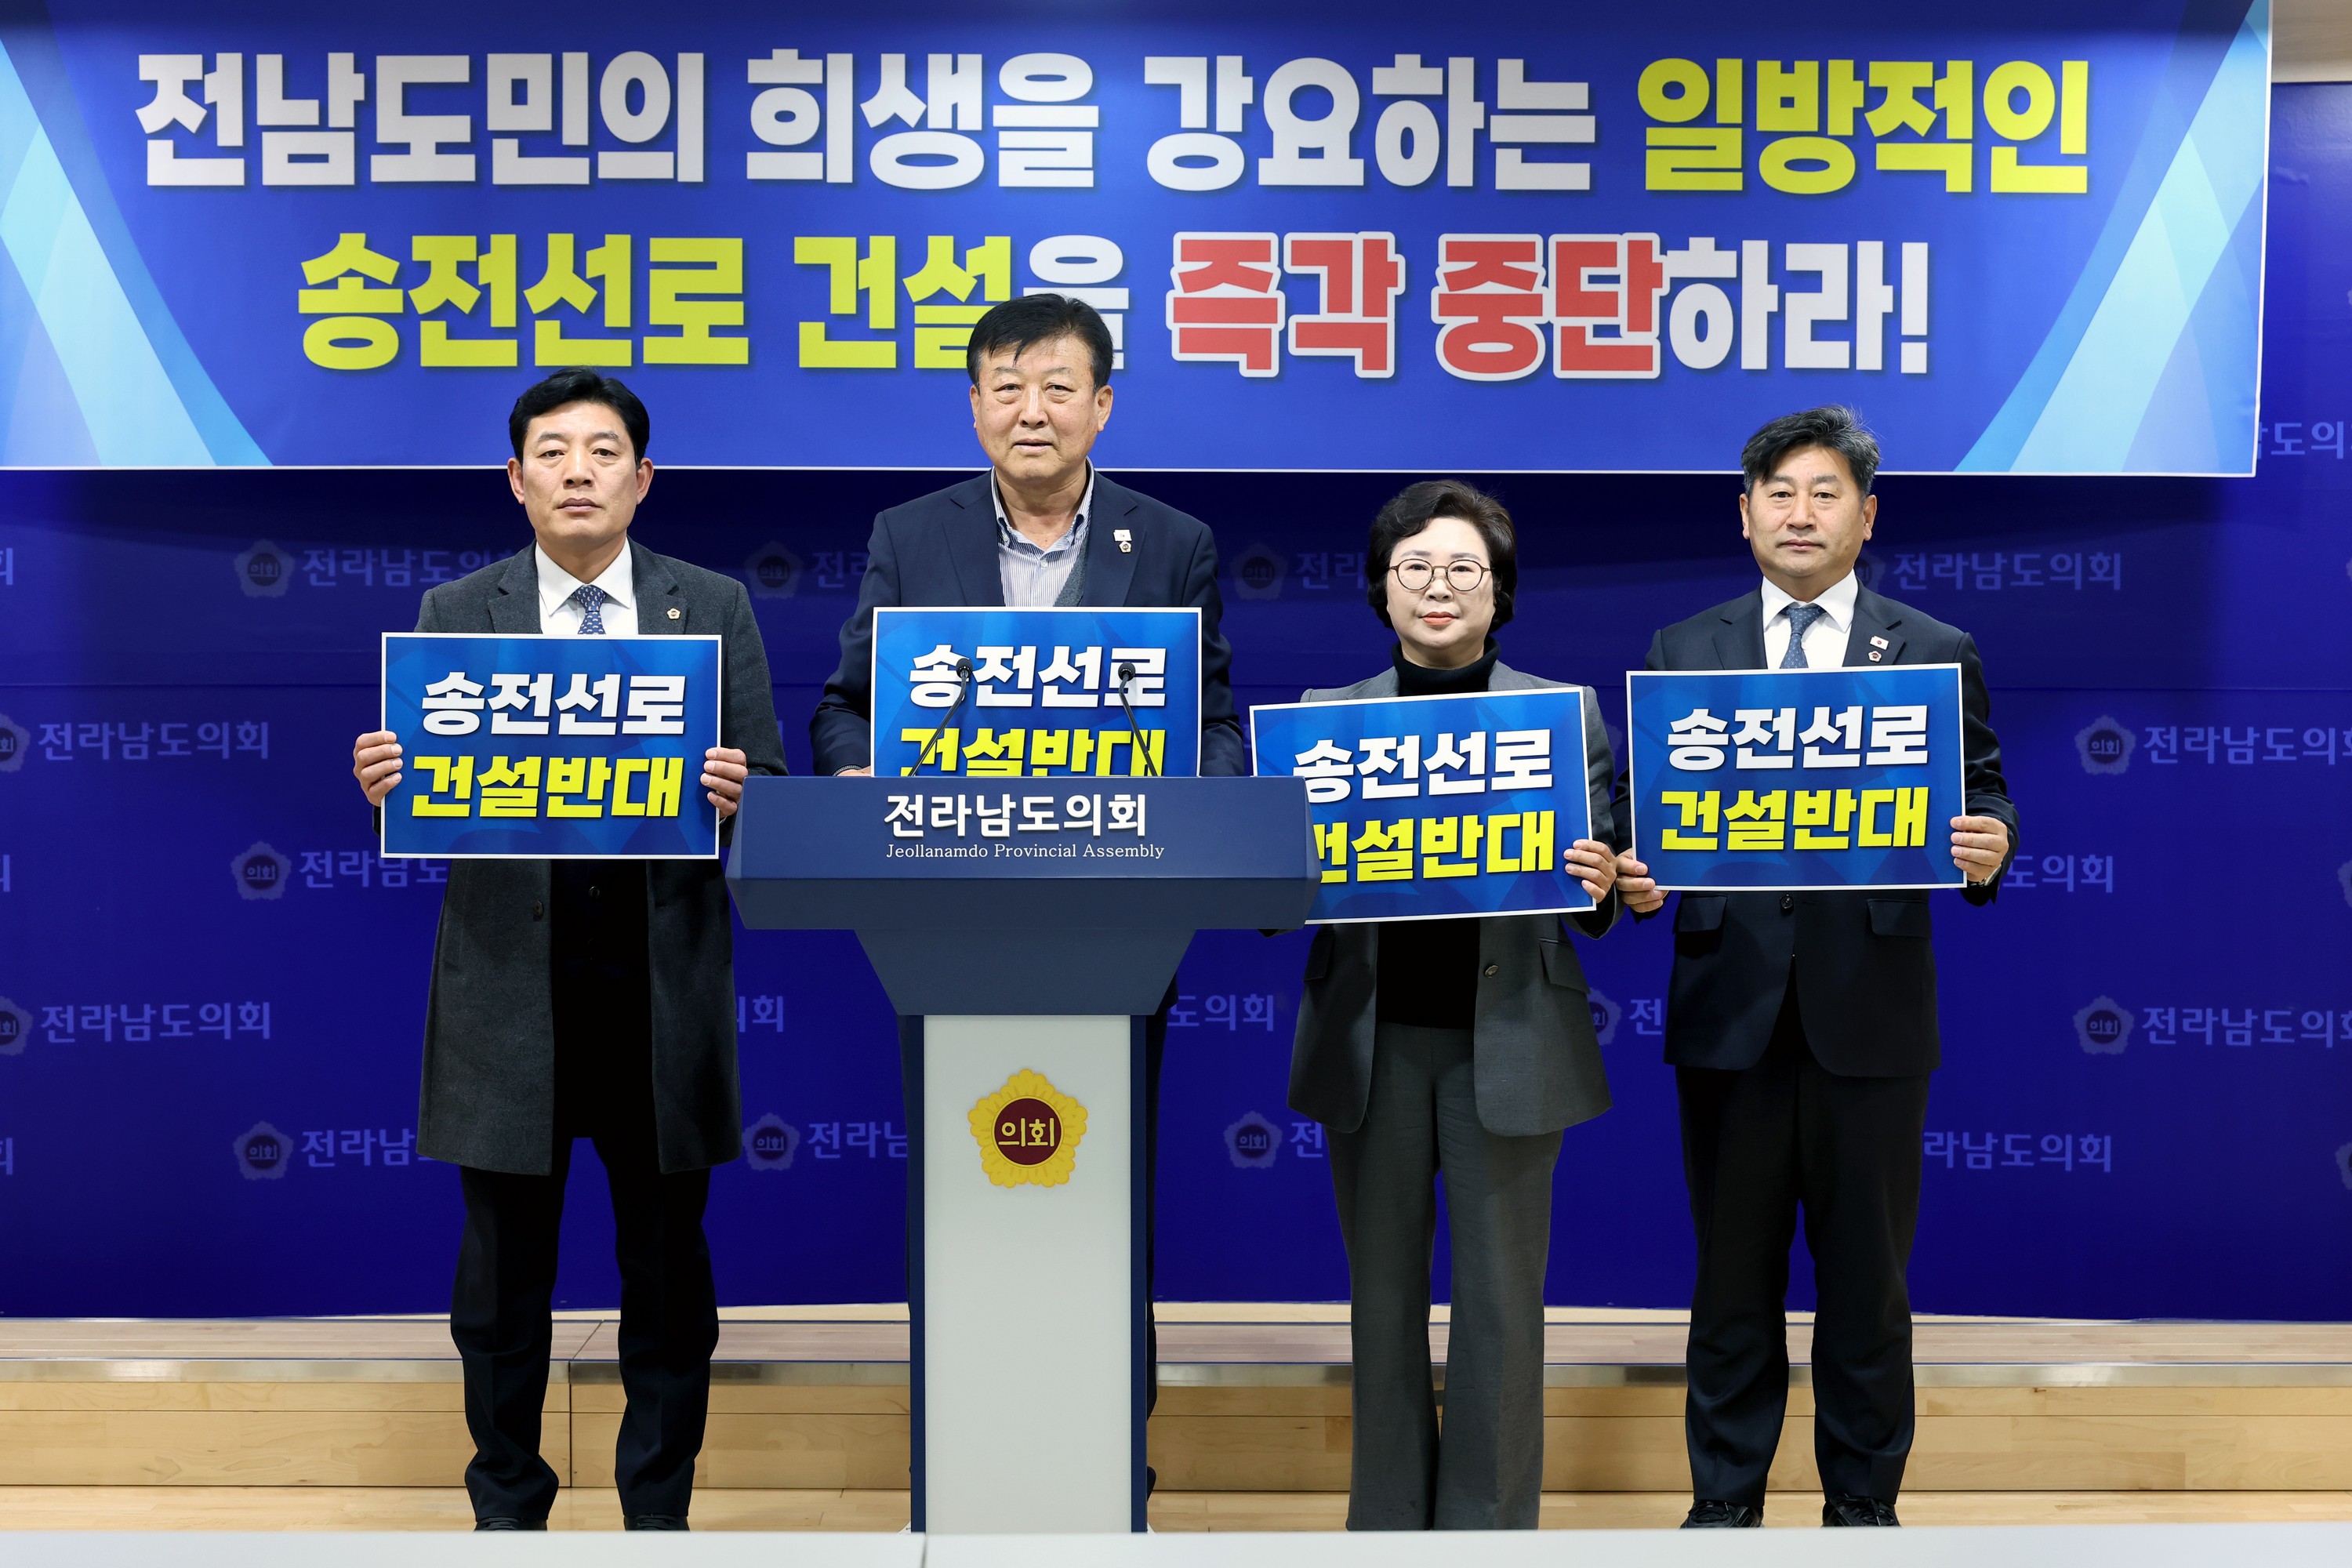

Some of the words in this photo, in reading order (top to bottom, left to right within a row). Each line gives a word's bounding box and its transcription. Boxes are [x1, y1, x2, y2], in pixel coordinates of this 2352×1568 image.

[136, 51, 704, 186] 전남도민의
[746, 49, 1099, 190] 희생을
[1144, 54, 1596, 191] 강요하는
[1637, 58, 2089, 194] 일방적인
[298, 233, 750, 370] 송전선로
[1167, 231, 1405, 378] 즉각
[1432, 233, 1929, 381] 중단하라!
[1893, 551, 2122, 590] 전라남도의회
[421, 671, 686, 736] 송전선로
[909, 644, 1167, 708] 송전선로
[38, 721, 269, 760] 전라남도의회
[1293, 729, 1553, 804] 송전선로
[1667, 705, 1929, 771] 송전선로
[412, 756, 684, 818] 건설반대
[884, 793, 1145, 837] 전라남도의회
[1661, 786, 1929, 851] 건설반대
[886, 844, 989, 858] Jeollanamdo
[993, 844, 1076, 858] Provincial
[1081, 844, 1165, 859] Assembly
[40, 1001, 271, 1044] 전라남도의회
[998, 1118, 1055, 1148] 의회
[1923, 1131, 2111, 1173] 라남도의회
